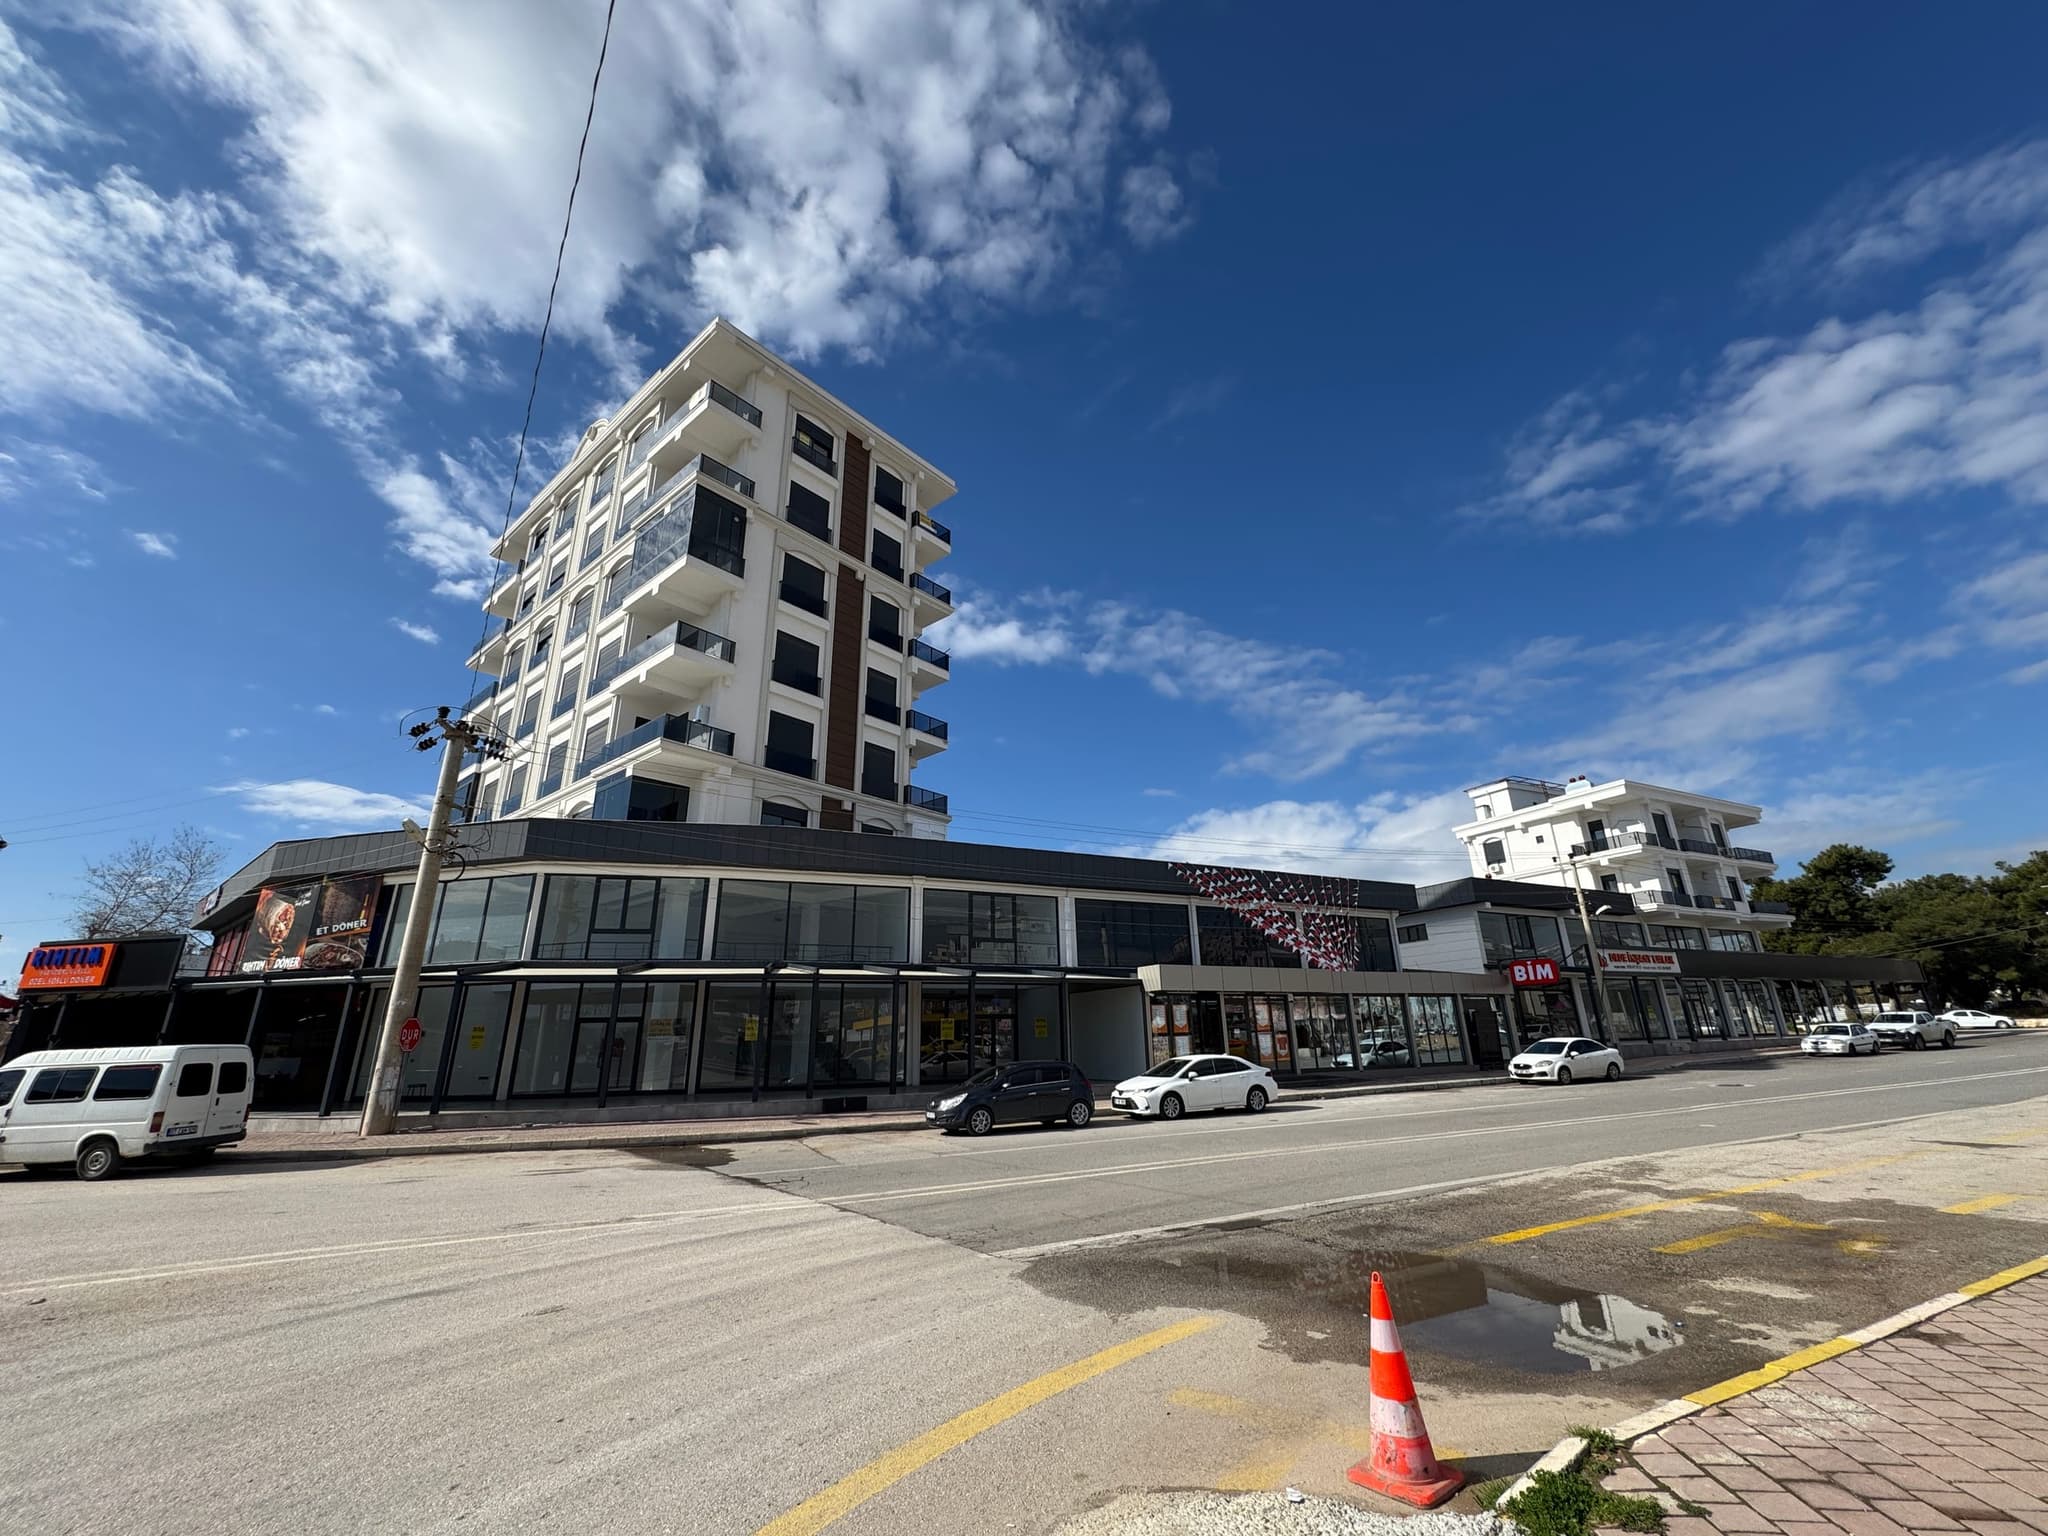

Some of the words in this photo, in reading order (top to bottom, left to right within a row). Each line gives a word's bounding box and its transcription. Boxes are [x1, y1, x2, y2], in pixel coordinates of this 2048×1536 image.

[316, 925, 329, 936] ET
[274, 956, 301, 969] DÖNER
[1513, 960, 1554, 982] BİM
[401, 1028, 419, 1041] DUR
